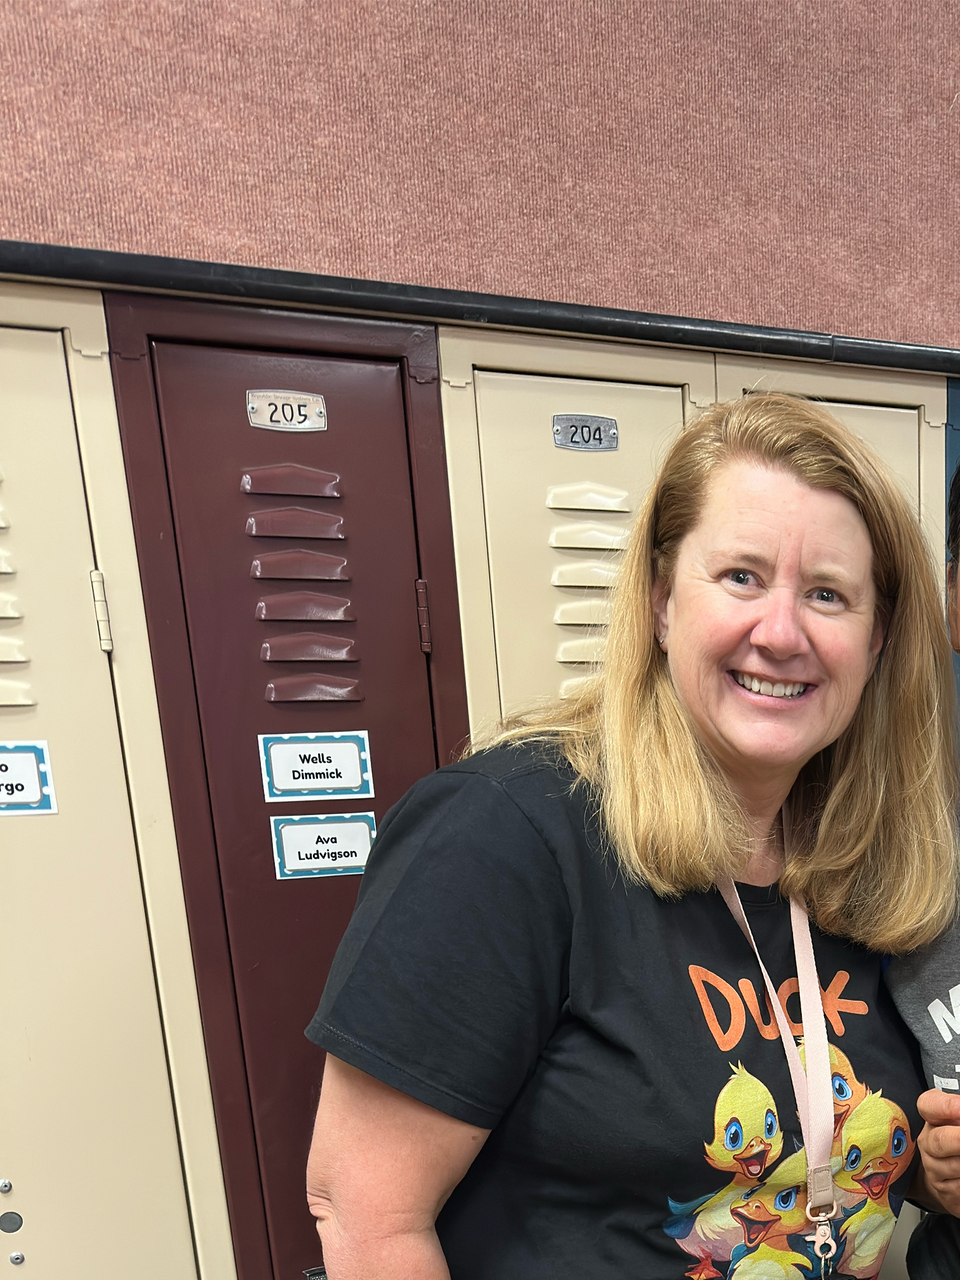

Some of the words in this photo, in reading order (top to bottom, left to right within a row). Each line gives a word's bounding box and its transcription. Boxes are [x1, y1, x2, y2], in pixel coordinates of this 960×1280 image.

[268, 402, 308, 424] 205
[570, 425, 602, 445] 204
[298, 753, 332, 764] Wells
[292, 768, 342, 780] Dimmick
[316, 835, 338, 844] Ava
[298, 849, 358, 861] Ludvigson
[688, 964, 869, 1051] DUCK
